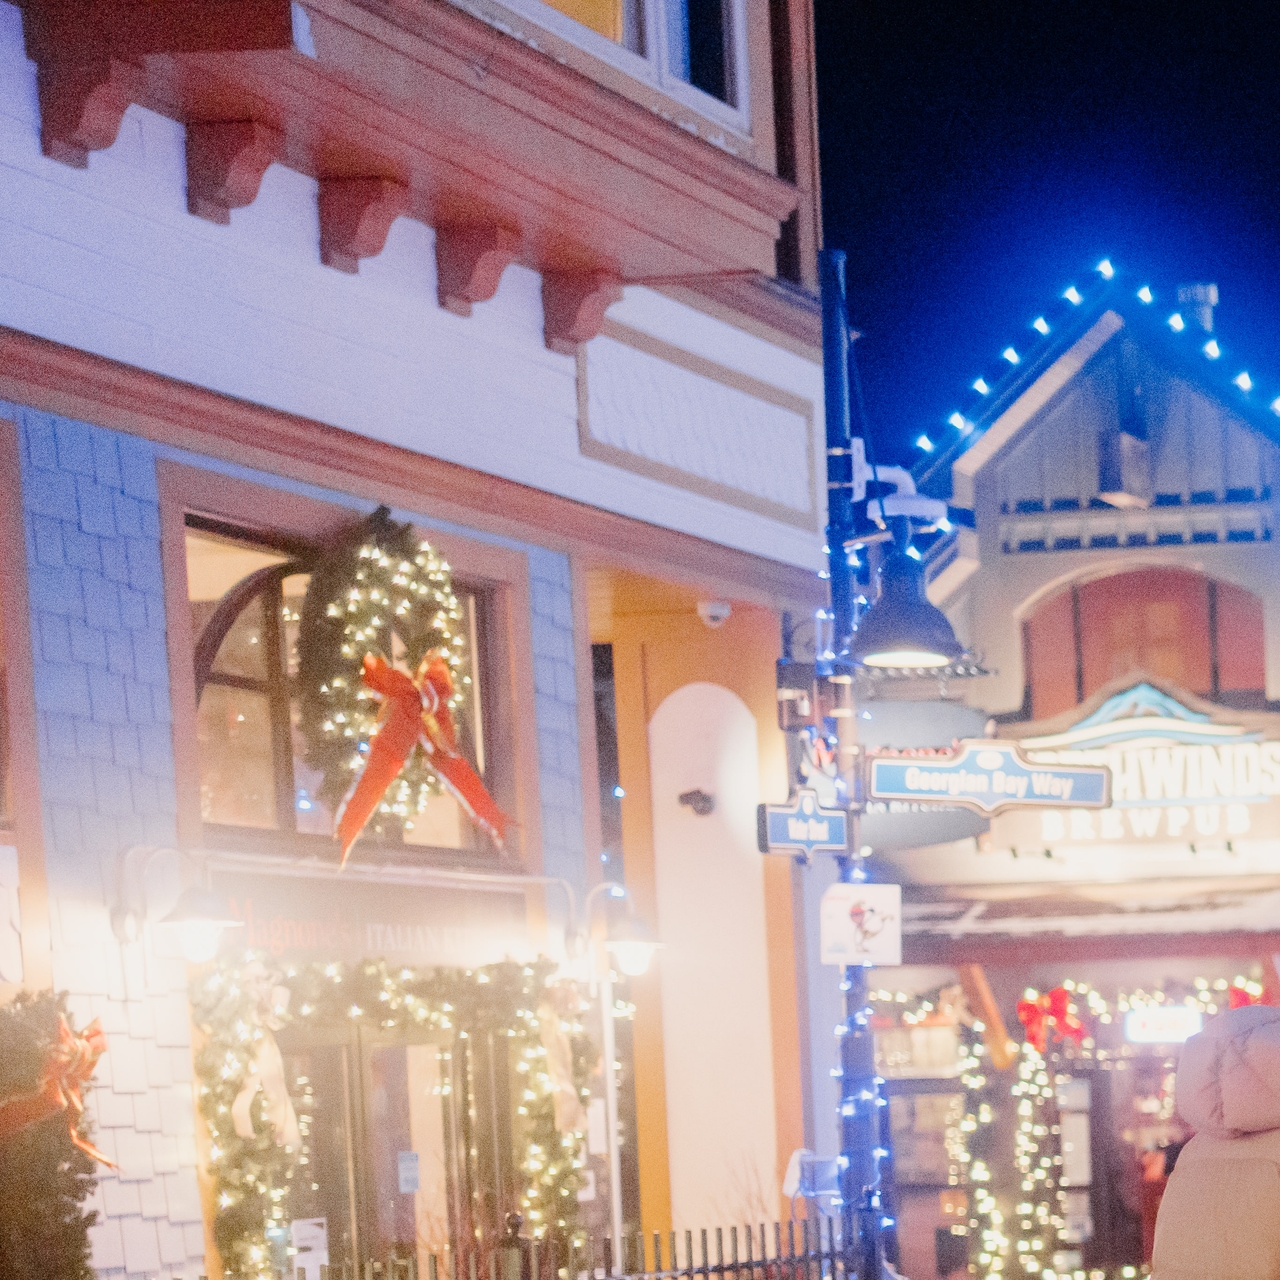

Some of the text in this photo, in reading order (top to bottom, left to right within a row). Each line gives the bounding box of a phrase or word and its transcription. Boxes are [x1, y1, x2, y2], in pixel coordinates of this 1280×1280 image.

[905, 767, 1074, 800] Georgian Bay Way
[1041, 804, 1251, 841] BREWPUB
